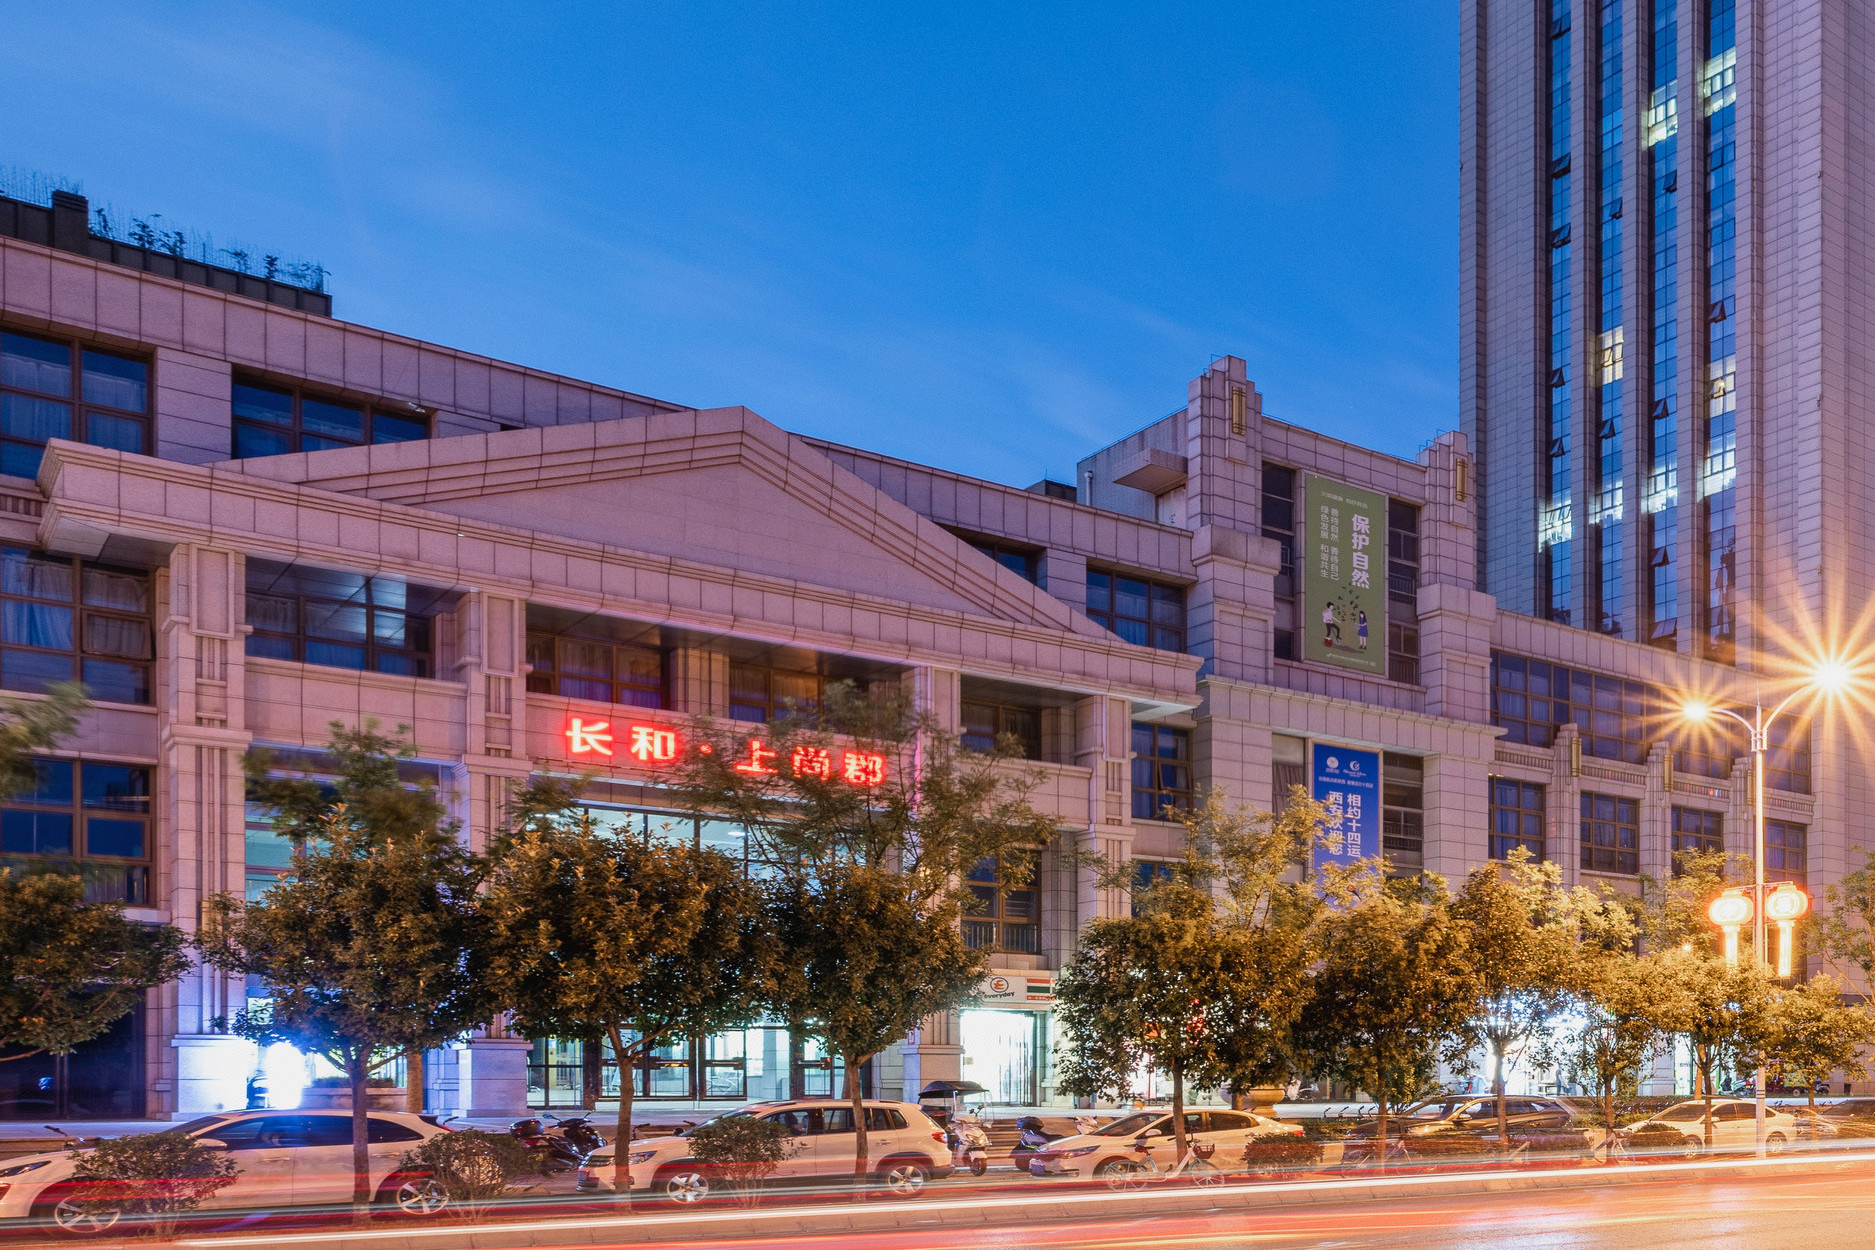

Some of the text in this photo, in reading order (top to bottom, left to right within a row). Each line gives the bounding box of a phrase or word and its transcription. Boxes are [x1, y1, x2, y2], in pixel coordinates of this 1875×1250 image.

[1351, 513, 1371, 589] 保护自然
[1347, 793, 1362, 858] 相约十四运
